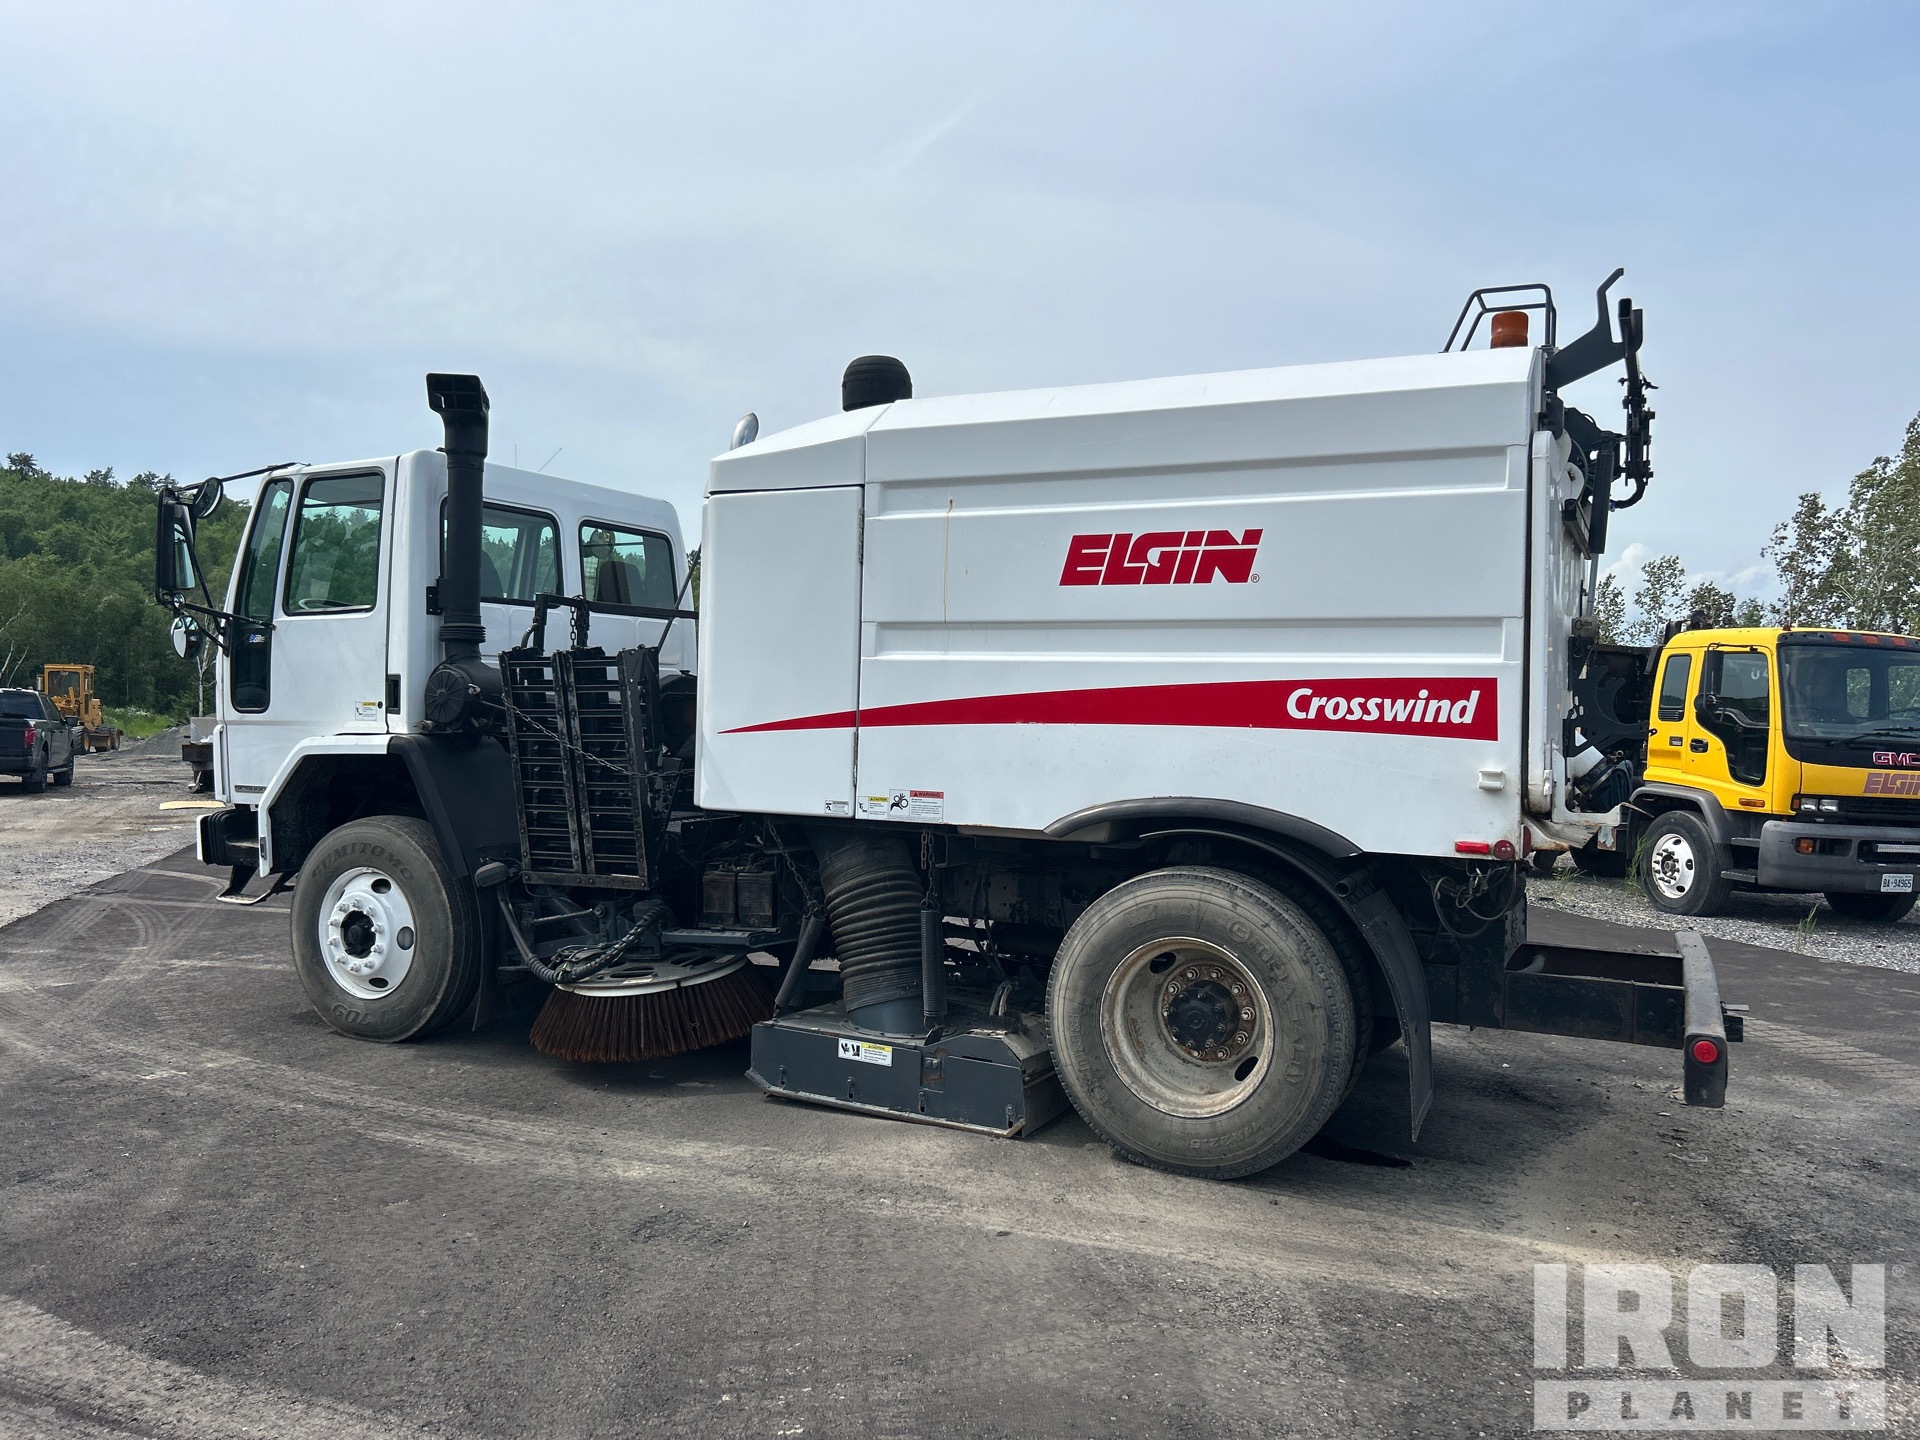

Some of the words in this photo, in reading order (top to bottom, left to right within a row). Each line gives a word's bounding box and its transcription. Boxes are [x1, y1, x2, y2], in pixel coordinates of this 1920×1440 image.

[1059, 528, 1264, 587] ELGIN
[1286, 687, 1481, 724] Crosswind
[1873, 751, 1920, 766] GMC
[312, 842, 414, 881] SUMITOMO
